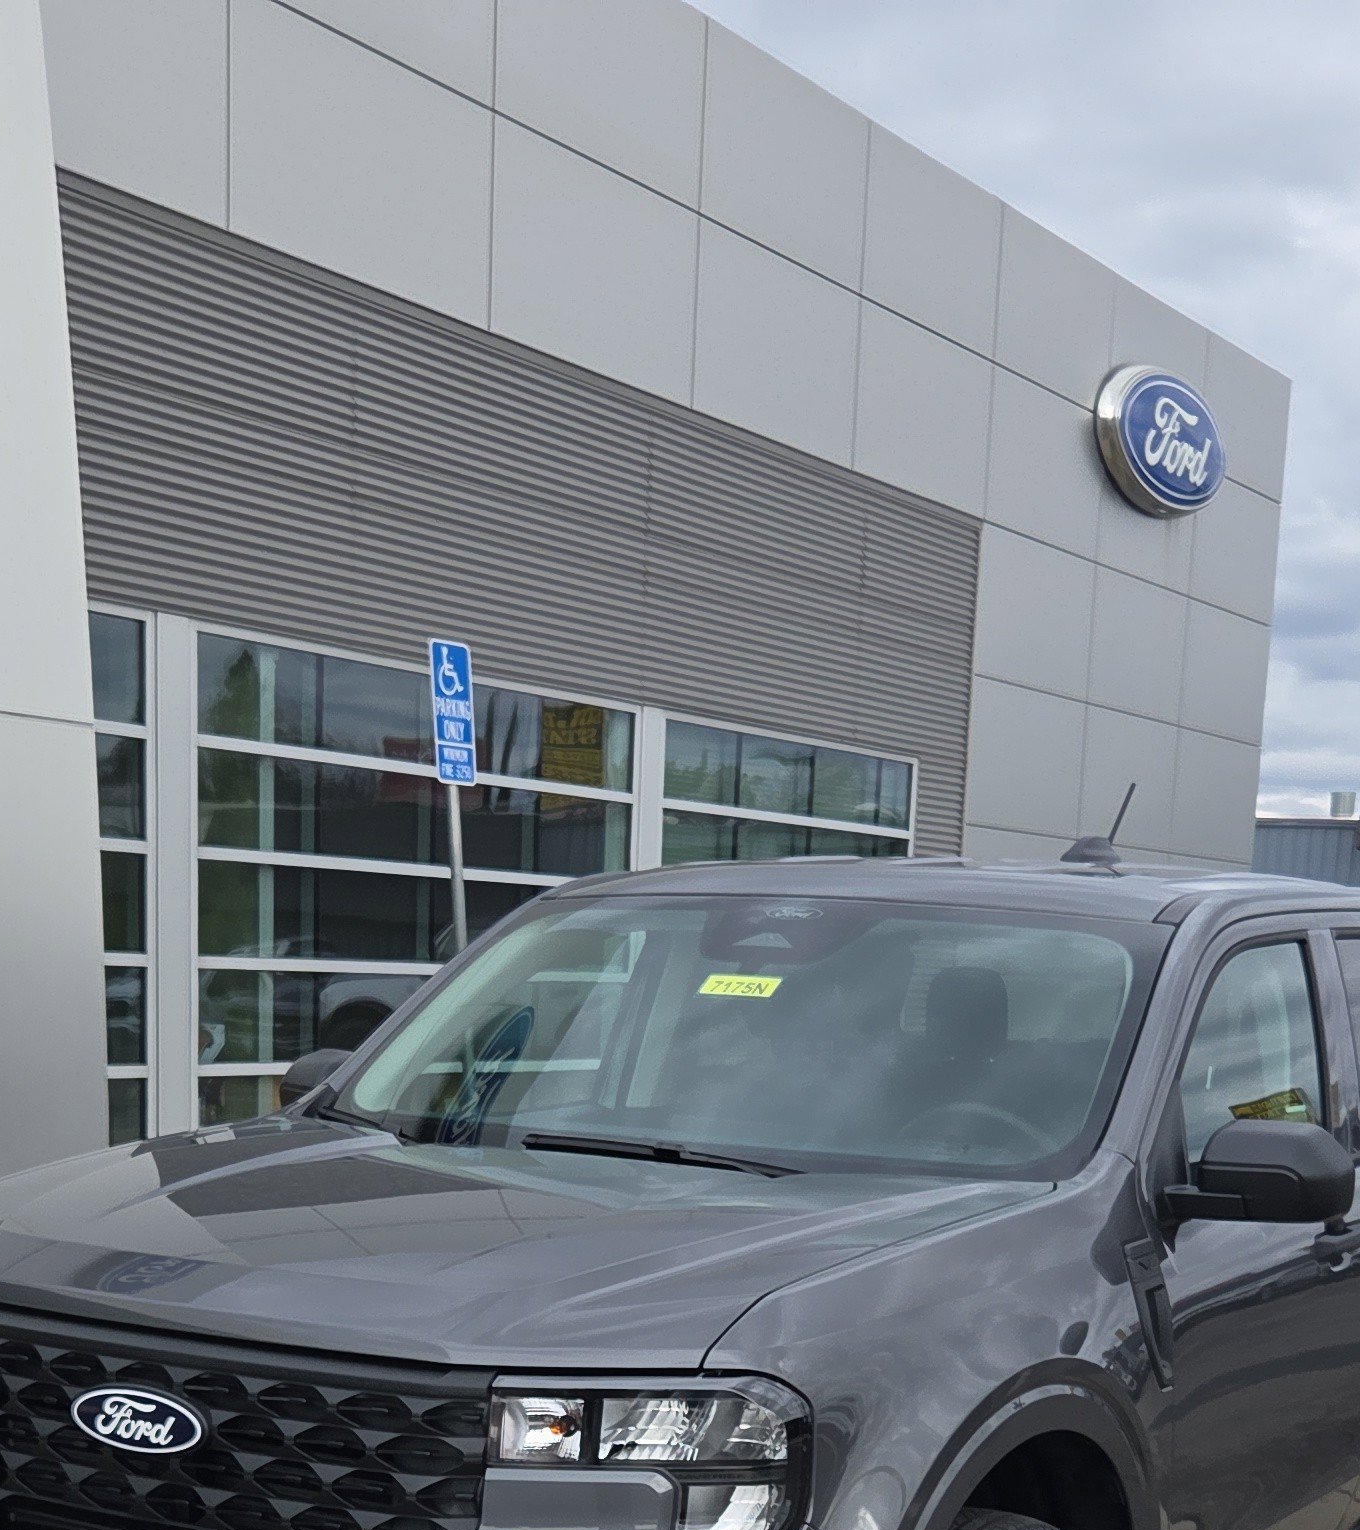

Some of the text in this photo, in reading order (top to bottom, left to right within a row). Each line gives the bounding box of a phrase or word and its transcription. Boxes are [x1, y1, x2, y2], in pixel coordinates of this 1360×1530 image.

[1144, 396, 1213, 488] Ford
[435, 696, 472, 721] PARKING
[443, 718, 465, 742] ONLY
[710, 980, 770, 994] 7175N
[94, 1395, 176, 1446] Ford
